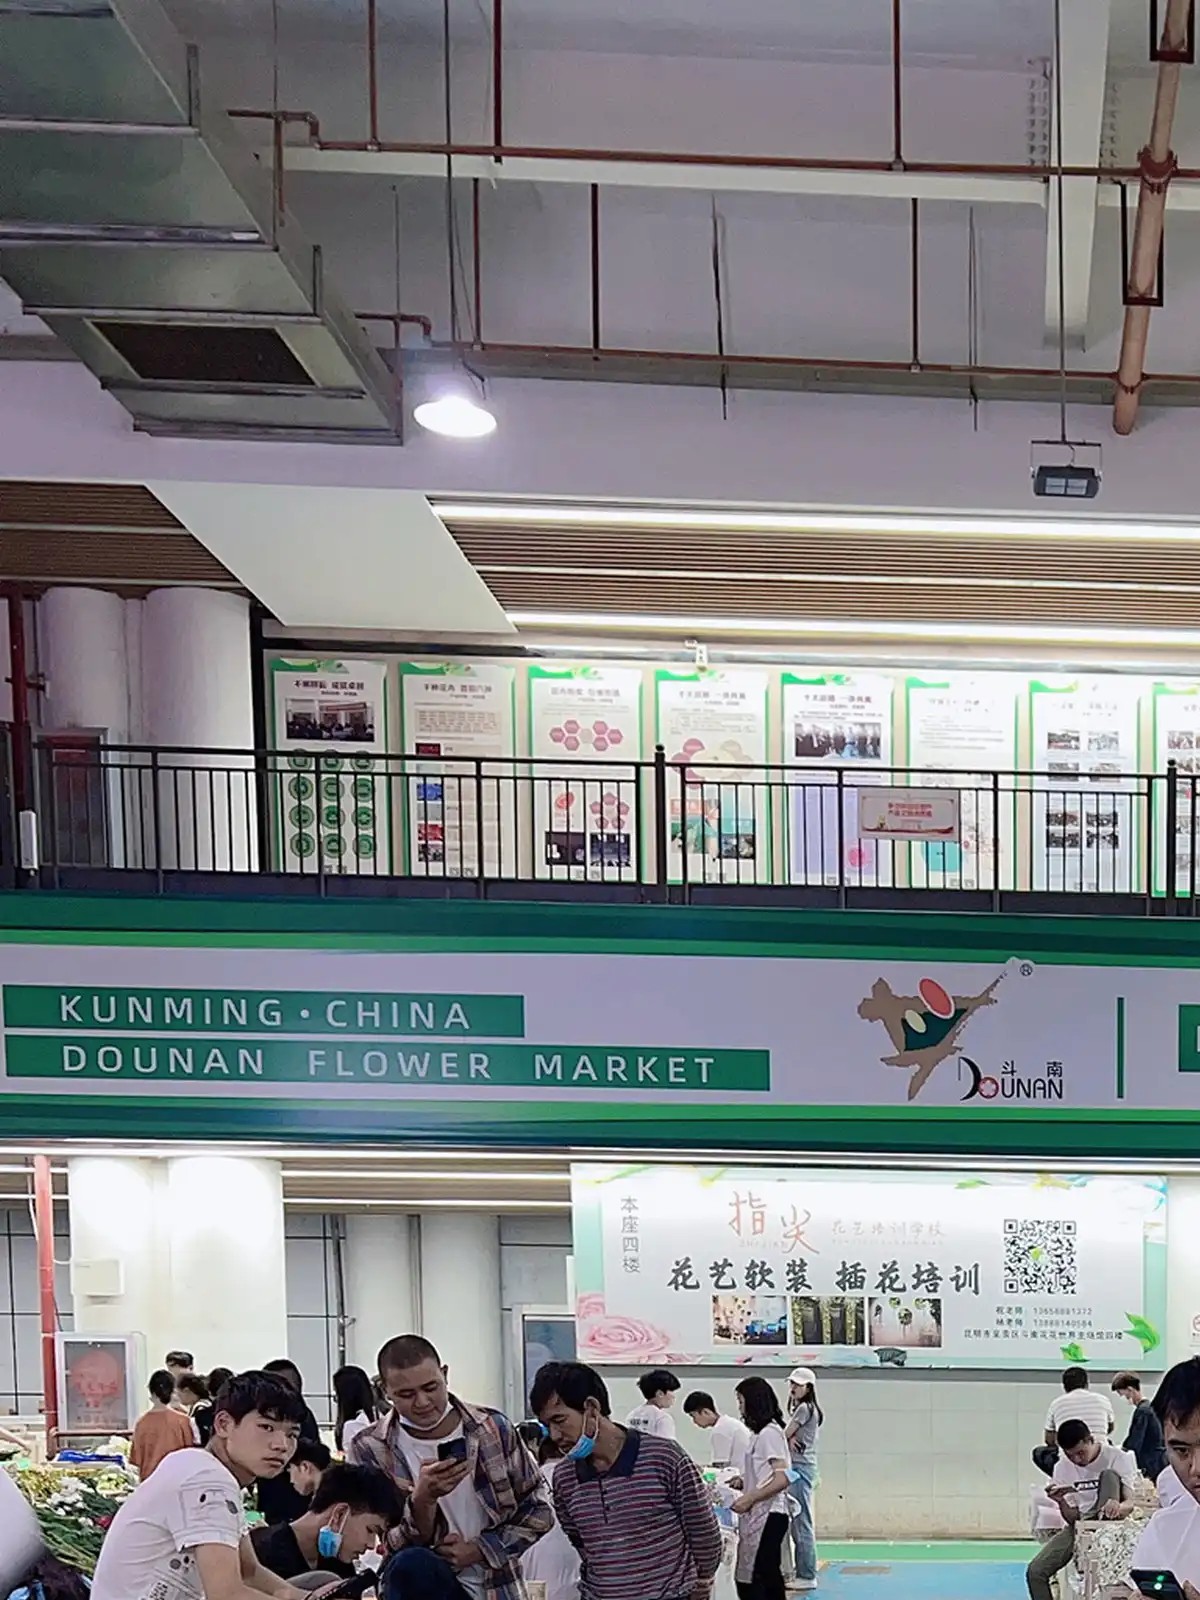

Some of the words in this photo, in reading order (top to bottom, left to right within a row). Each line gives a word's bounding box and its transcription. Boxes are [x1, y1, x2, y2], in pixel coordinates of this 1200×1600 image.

[62, 1044, 266, 1076] DOUNAN
[308, 1049, 492, 1081] FLOWER
[534, 1053, 715, 1085] MARKET
[958, 1056, 1063, 1101] DOUNAN
[620, 1195, 640, 1274] 本座四楼
[729, 1191, 820, 1254] 指尖
[667, 1256, 812, 1294] 花艺软装
[835, 1259, 980, 1296] 插花培训
